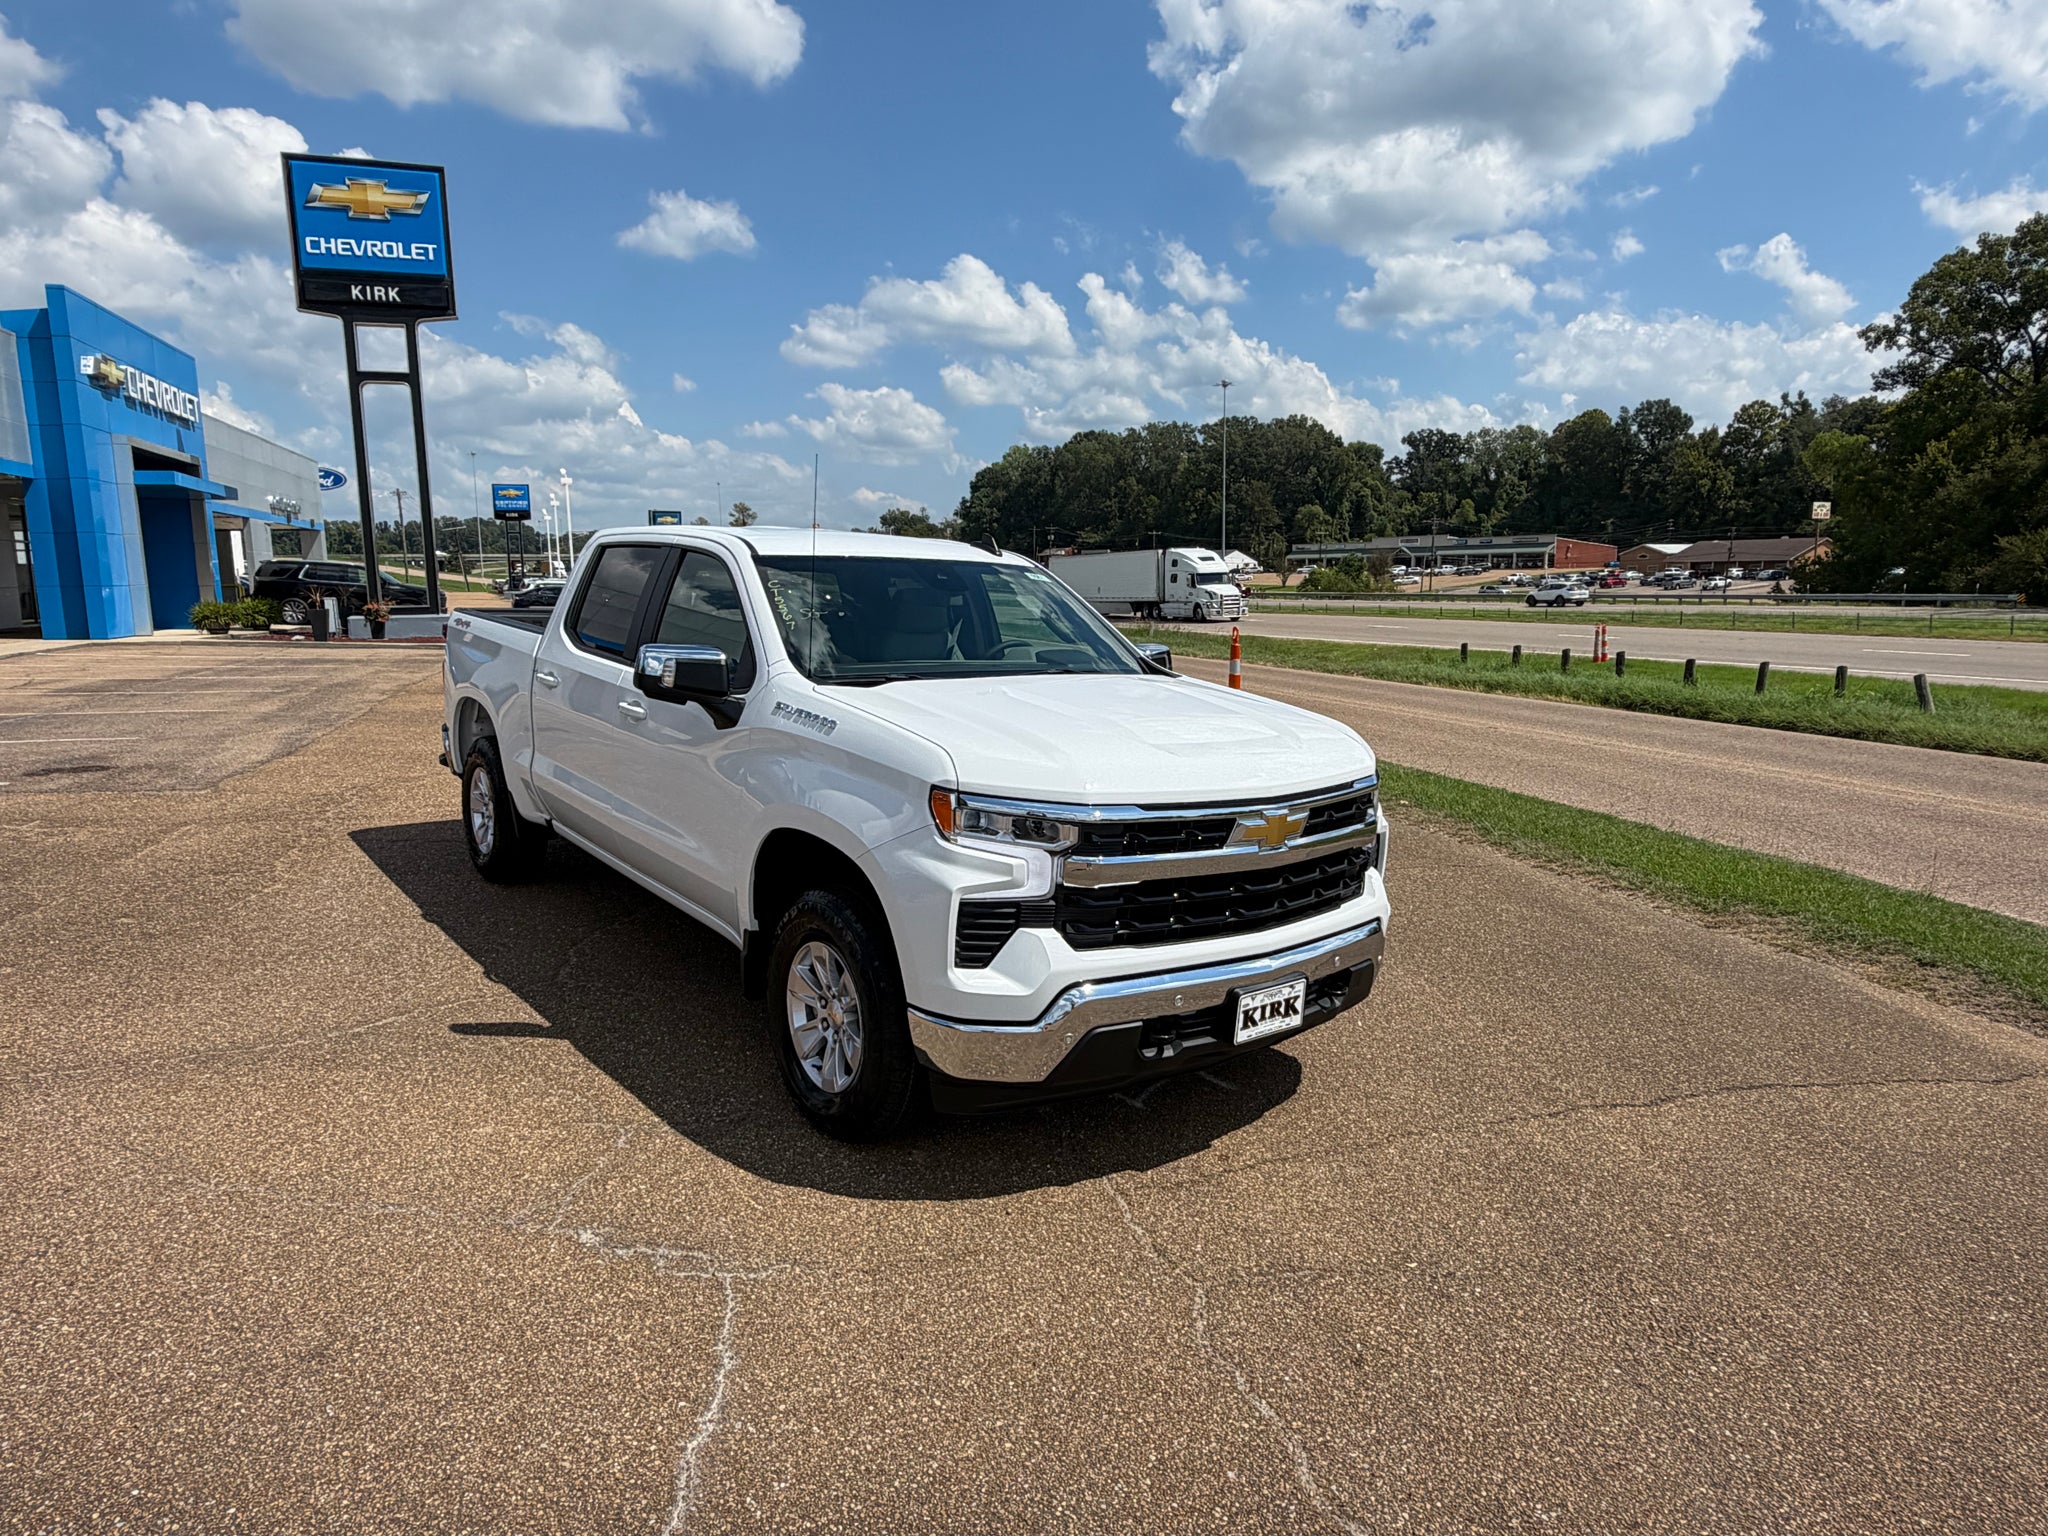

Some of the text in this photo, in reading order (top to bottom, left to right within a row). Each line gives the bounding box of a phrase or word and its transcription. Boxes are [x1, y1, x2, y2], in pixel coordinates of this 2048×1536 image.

[305, 236, 437, 261] CHEVROLET
[351, 285, 401, 302] KIRK
[126, 366, 199, 423] CHEVROLET
[1240, 994, 1301, 1031] KIRK
